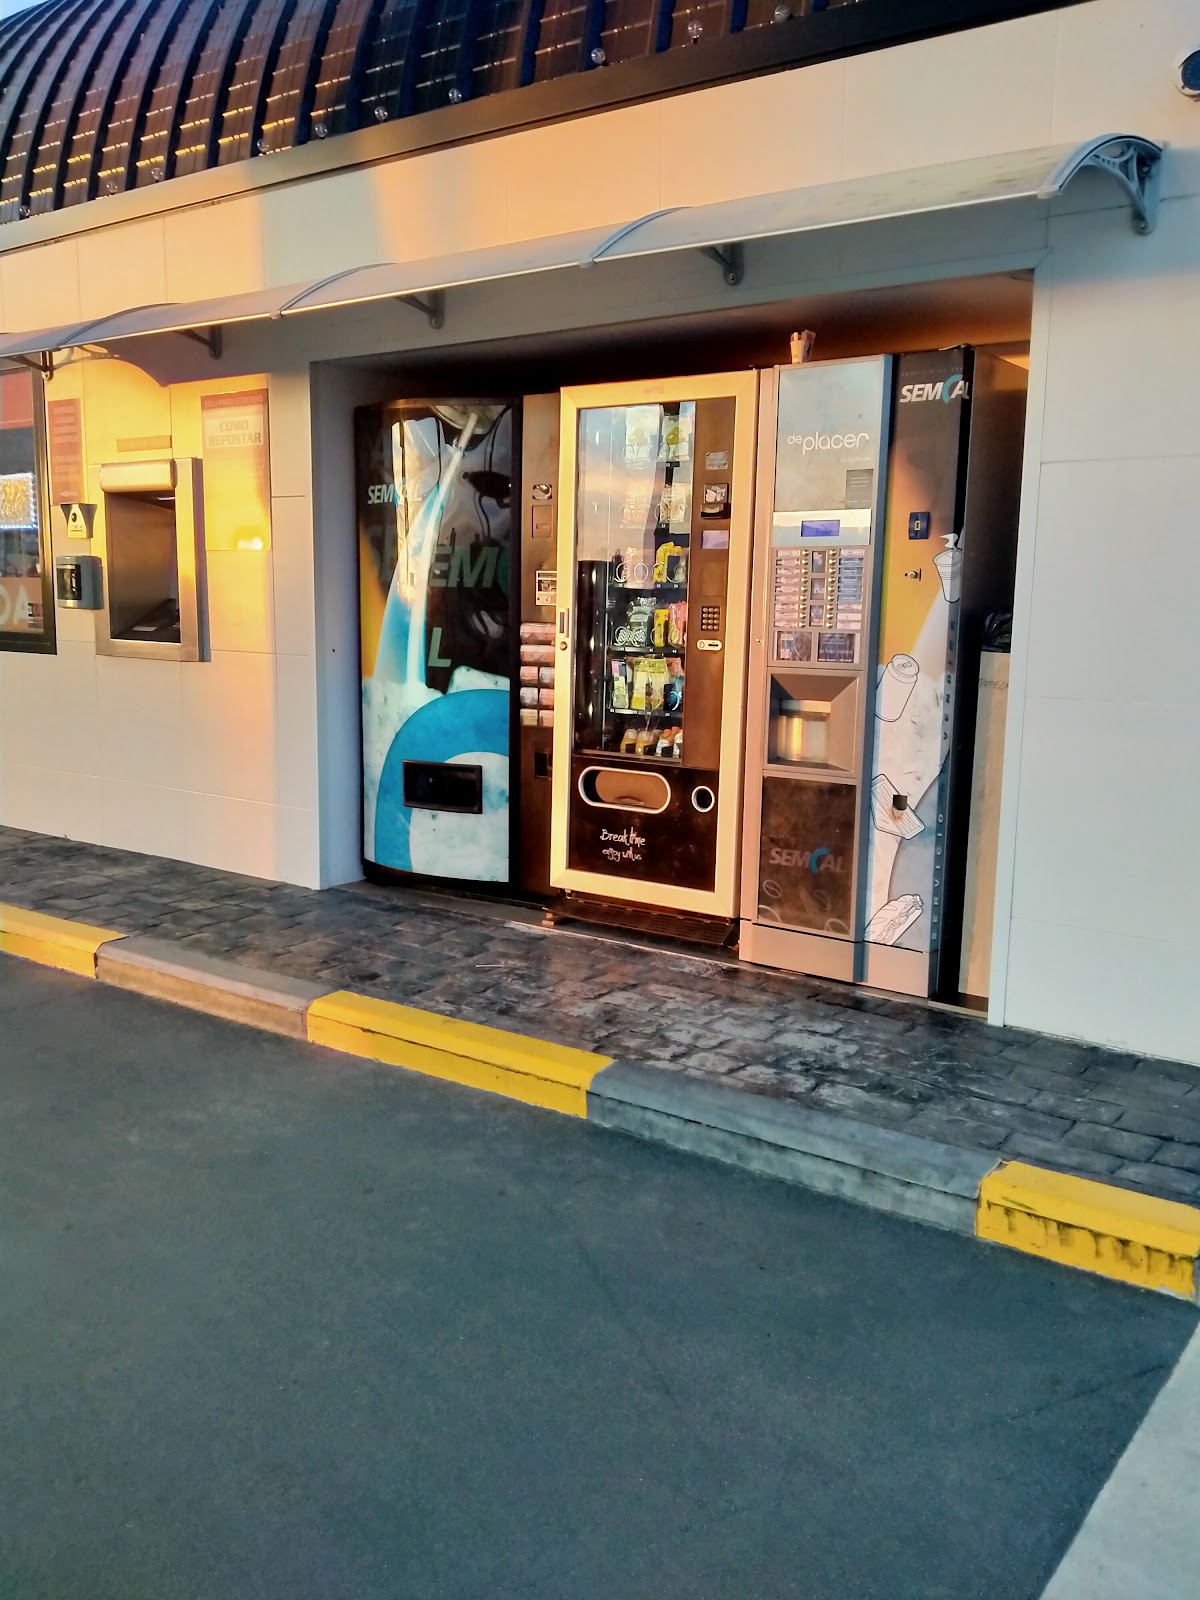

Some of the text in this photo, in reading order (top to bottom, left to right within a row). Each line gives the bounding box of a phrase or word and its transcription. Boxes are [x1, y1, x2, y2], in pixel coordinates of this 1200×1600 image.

[208, 432, 261, 446] REPOSTAR
[787, 431, 870, 456] de placer
[600, 828, 630, 847] Break
[769, 847, 847, 876] SEMCAL
